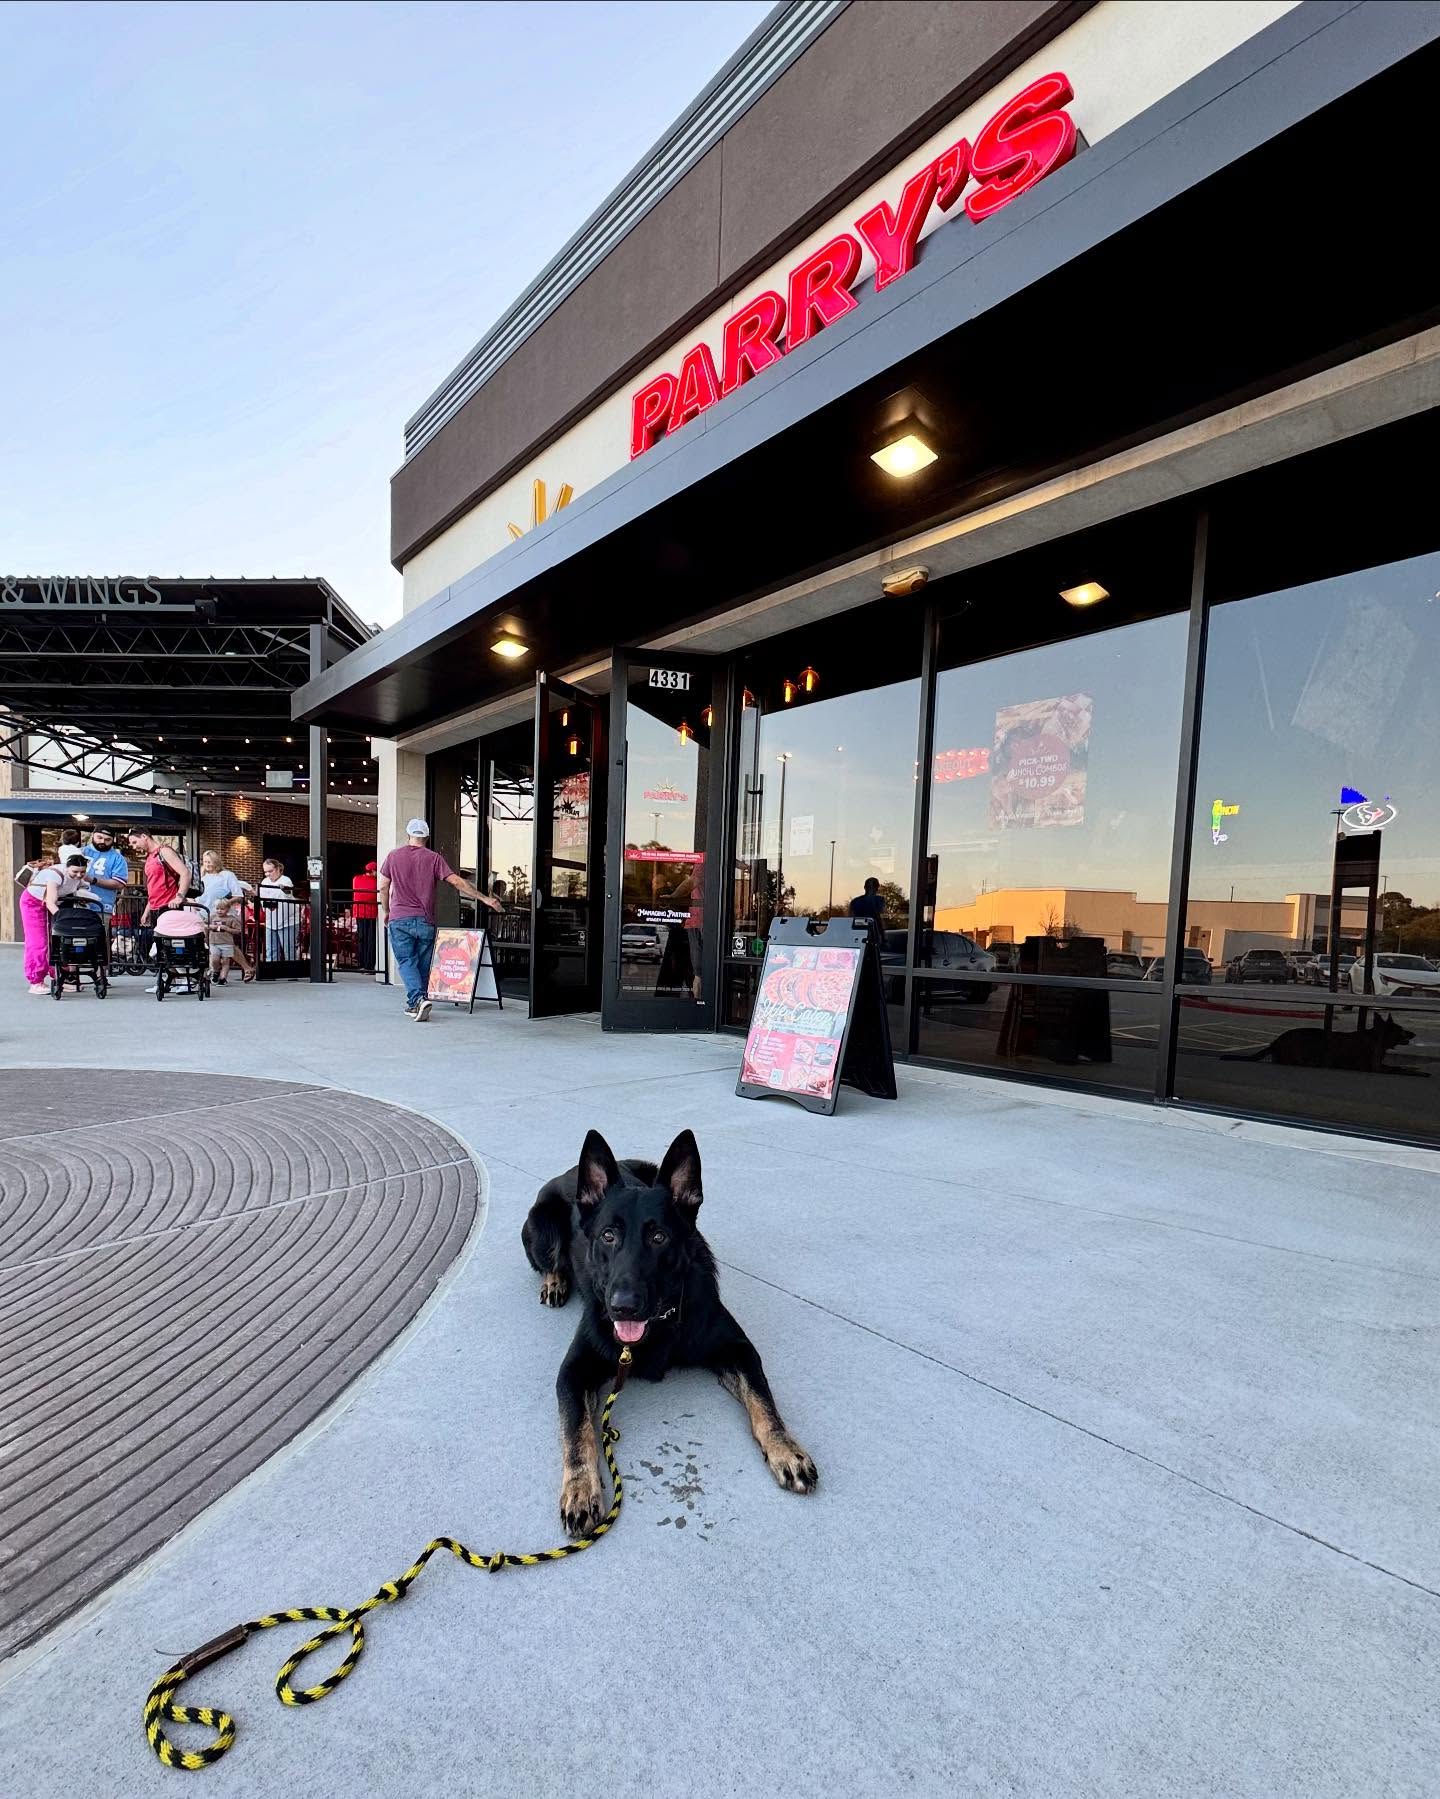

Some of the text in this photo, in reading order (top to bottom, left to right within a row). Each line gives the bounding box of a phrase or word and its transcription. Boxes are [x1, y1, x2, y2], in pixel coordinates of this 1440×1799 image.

[630, 71, 1078, 461] PARRY'S
[1, 575, 162, 605] & WINGS
[650, 670, 688, 690] 4331
[932, 758, 975, 775] AKEOUT
[1018, 754, 1058, 766] PICK-TWO
[1019, 774, 1056, 789] $10.99
